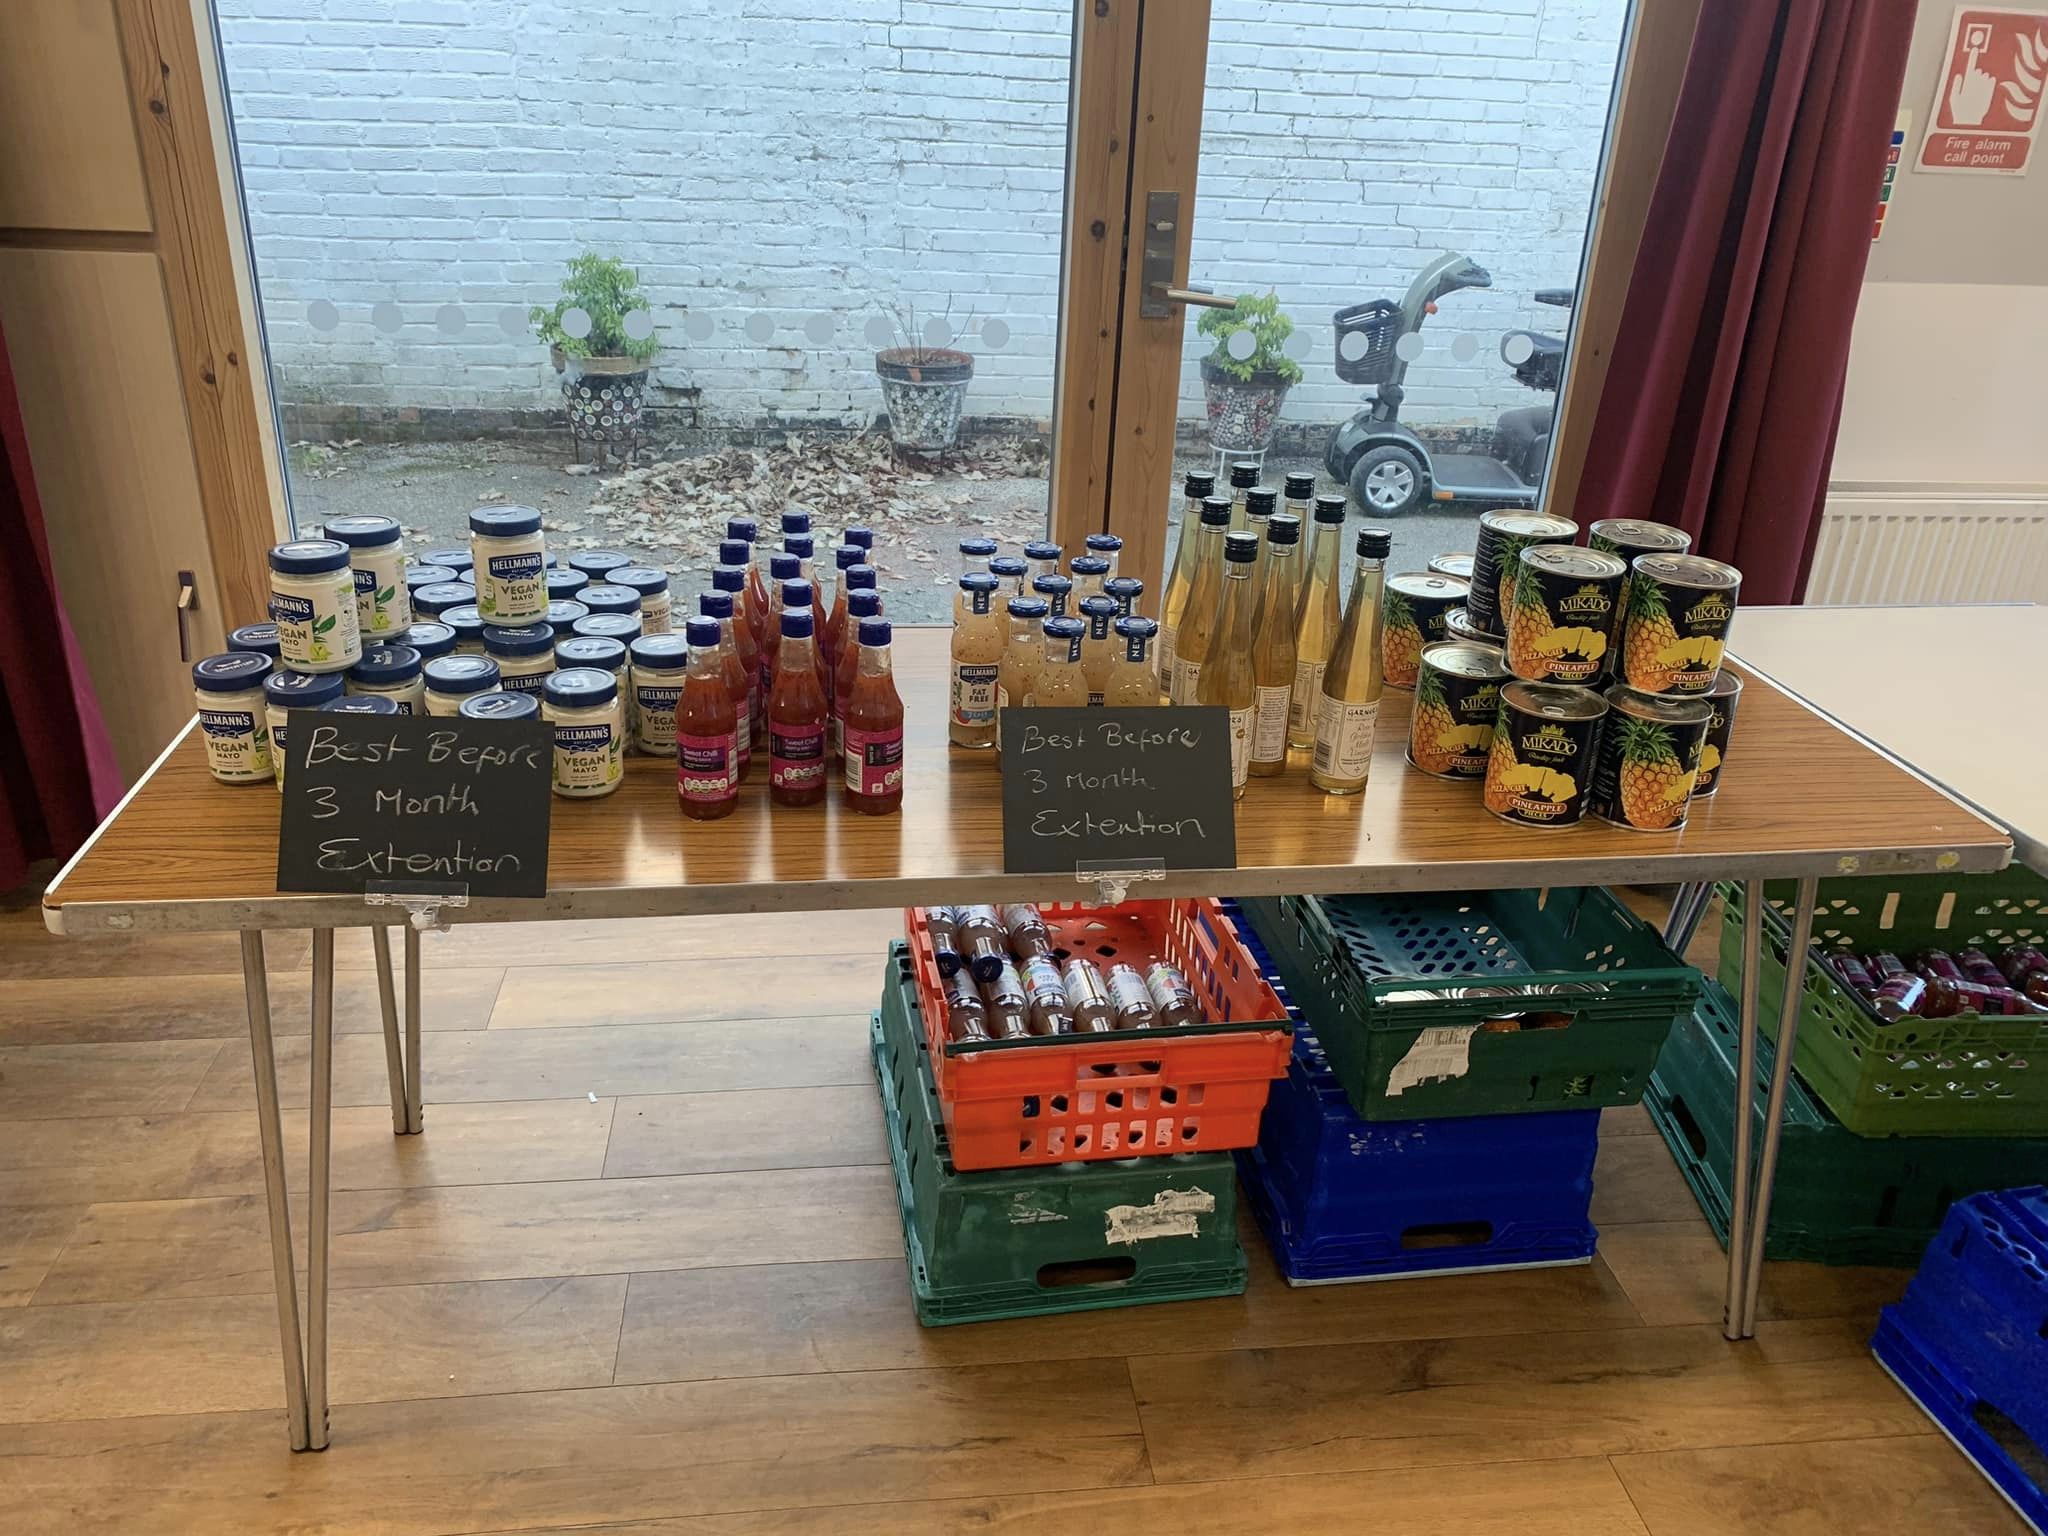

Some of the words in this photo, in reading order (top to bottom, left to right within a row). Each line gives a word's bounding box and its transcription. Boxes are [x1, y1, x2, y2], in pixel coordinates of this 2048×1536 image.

[1945, 136, 1970, 150] Fire
[1975, 138, 2012, 151] alarm
[1943, 151, 1968, 162] call
[1970, 153, 2005, 166] point
[492, 554, 541, 571] HELLMANN'S
[501, 581, 540, 596] VEGAN
[511, 593, 534, 602] MAYO
[1055, 592, 1063, 613] NEW
[1119, 594, 1127, 615] NEW
[1559, 599, 1612, 613] MIKADO
[1684, 606, 1732, 623] MIKADO
[1132, 636, 1140, 657] NEW
[1549, 662, 1596, 672] PINEAPPLE
[968, 695, 989, 703] FREE
[646, 715, 676, 726] VEGA
[555, 727, 609, 741] HELLMANN'S
[1021, 725, 1088, 754] Best
[1097, 722, 1202, 752] Before
[208, 740, 249, 752] VEGAN
[305, 726, 411, 769] Best
[427, 730, 544, 774] Before
[1522, 735, 1578, 756] MIKADO
[563, 755, 606, 767] VEGAN
[1023, 769, 1048, 794] 3
[1066, 767, 1157, 791] Month
[306, 786, 340, 819] 3
[376, 783, 479, 817] Month
[1512, 798, 1562, 813] PINEAPPLE
[1031, 809, 1207, 839] Extention
[316, 837, 521, 875] Extention
